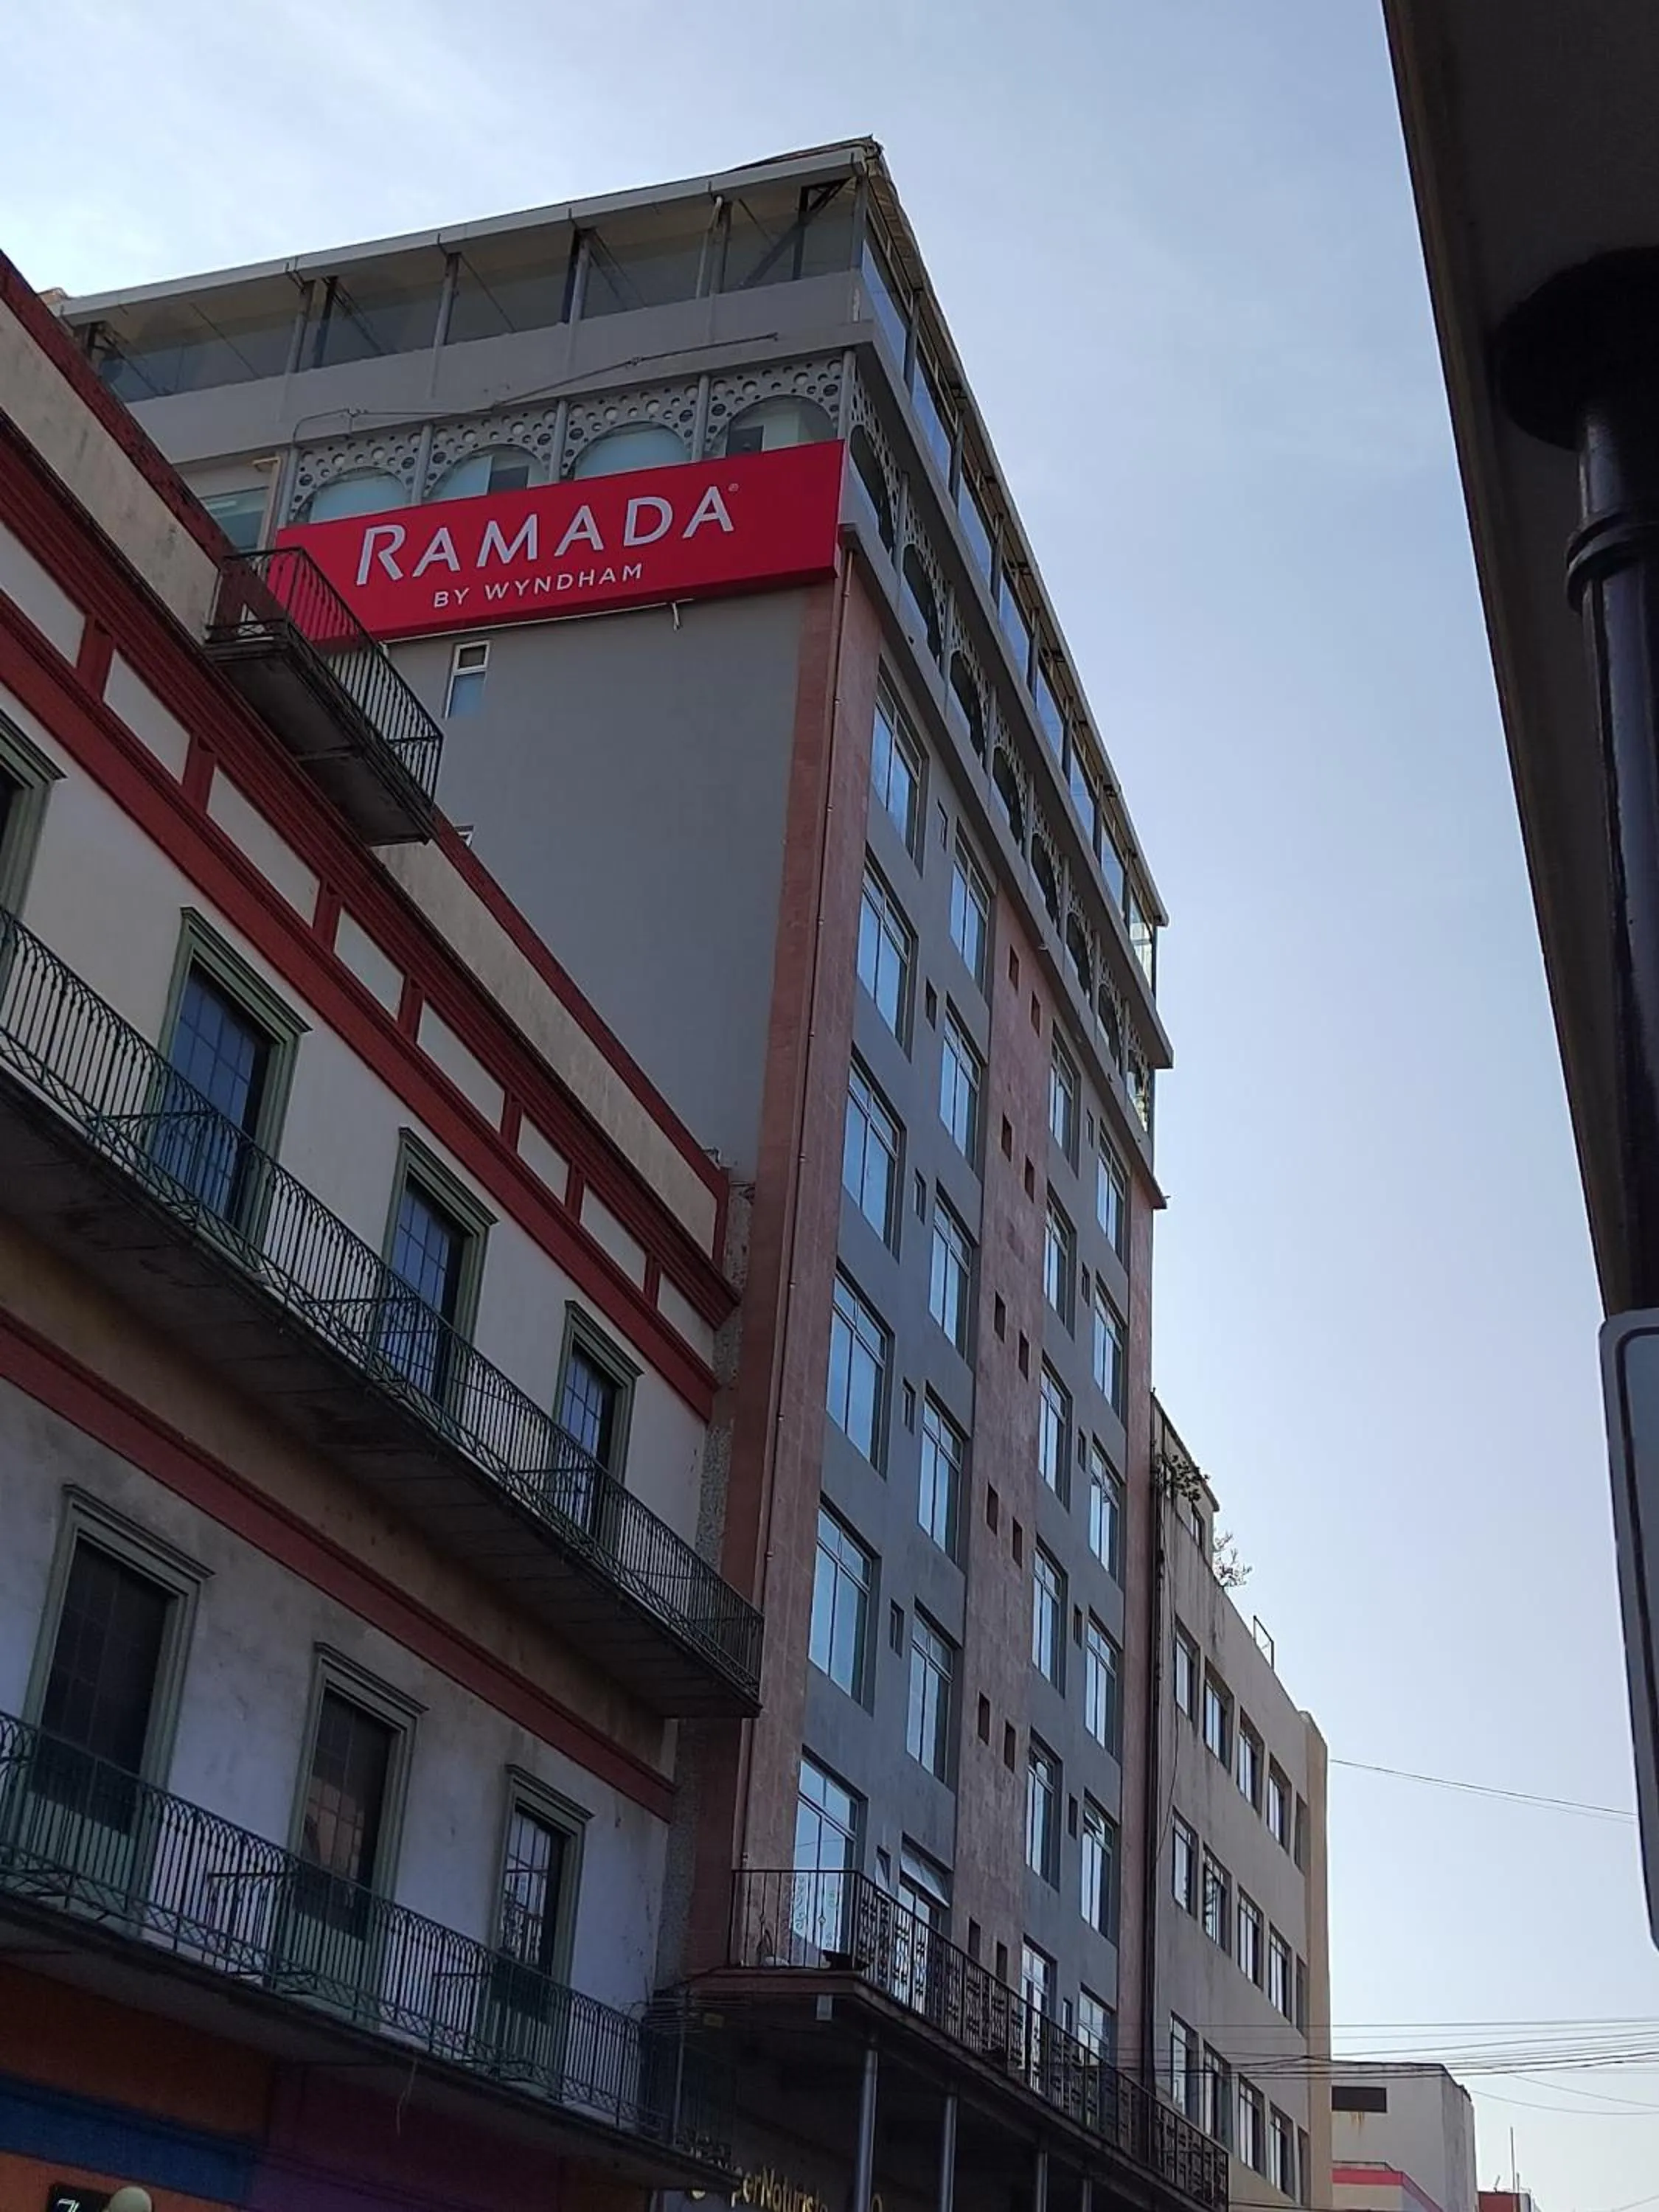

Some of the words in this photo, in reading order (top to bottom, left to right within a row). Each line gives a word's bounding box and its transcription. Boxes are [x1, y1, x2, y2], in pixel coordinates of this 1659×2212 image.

[356, 485, 734, 586] RAMADA
[433, 588, 470, 608] BY
[484, 563, 642, 600] WYNDHAM
